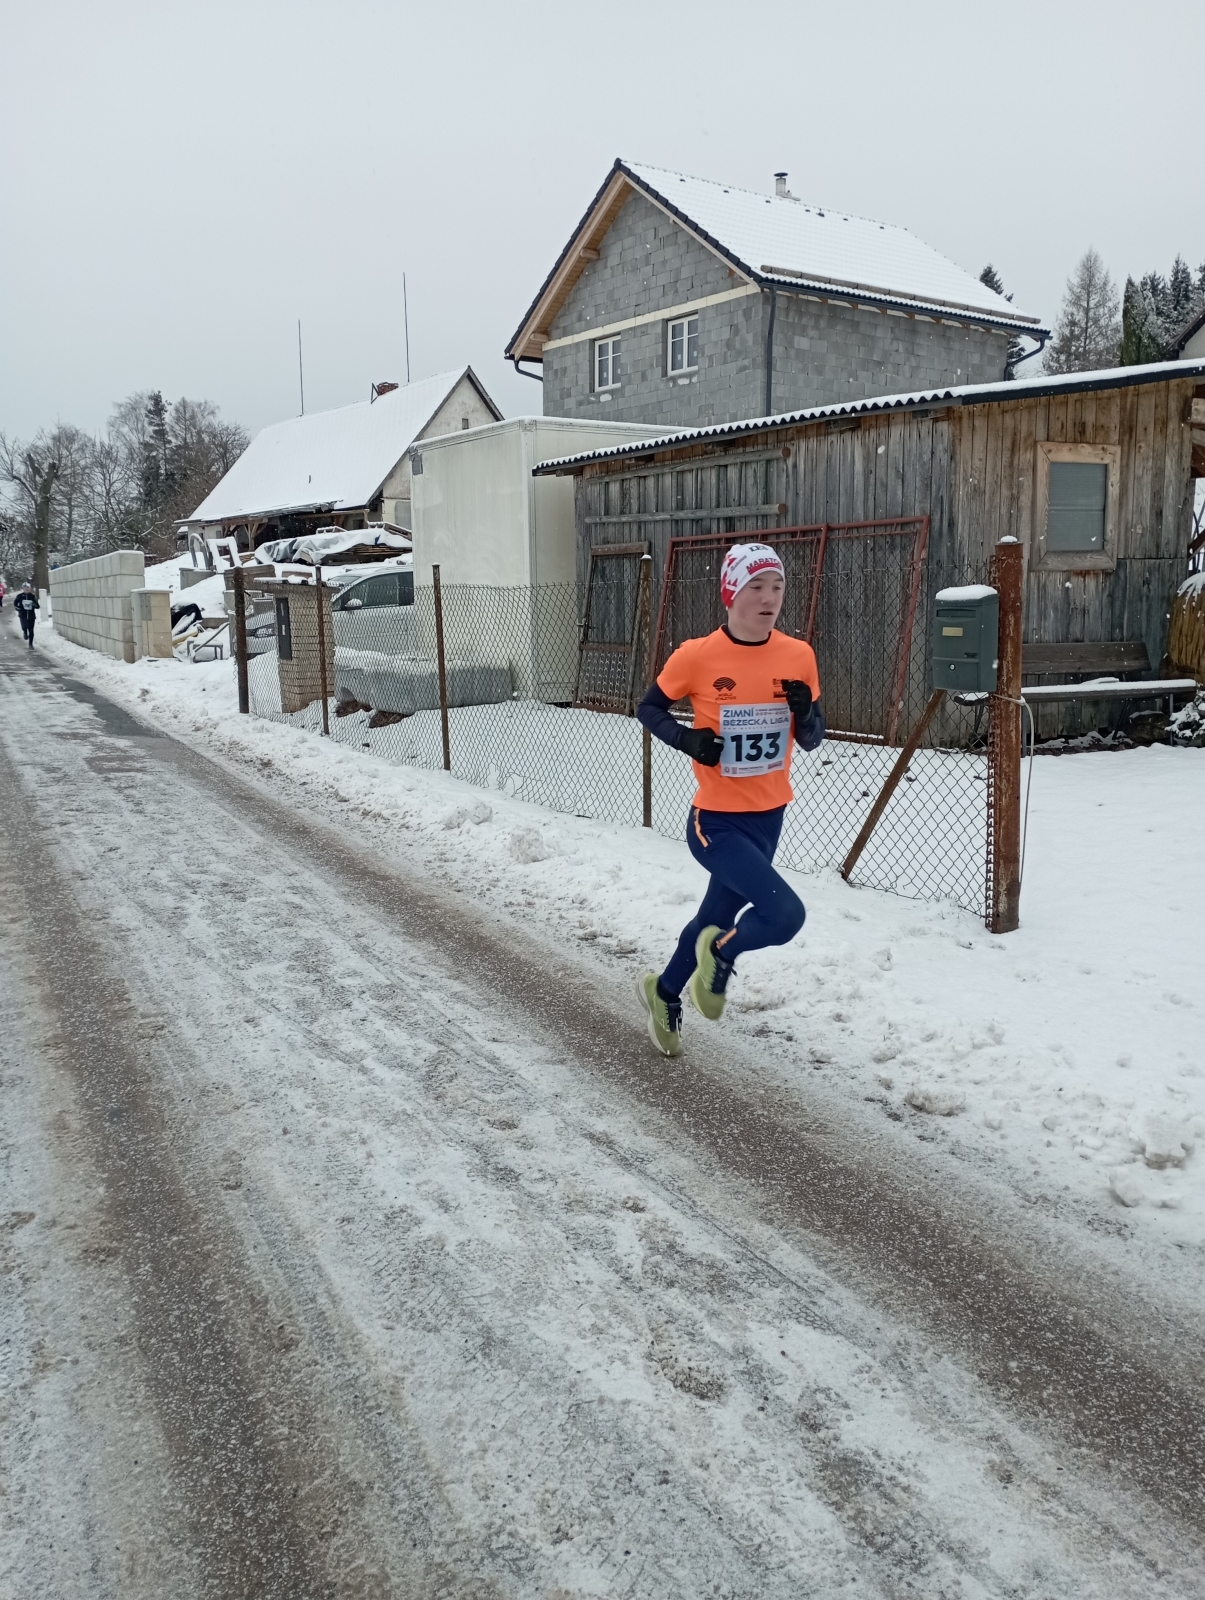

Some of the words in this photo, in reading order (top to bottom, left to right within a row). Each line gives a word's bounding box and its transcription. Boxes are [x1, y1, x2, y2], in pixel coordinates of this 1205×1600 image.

[723, 707, 754, 718] ZIMNÍ
[770, 716, 789, 725] LIGA
[730, 731, 781, 762] 133
